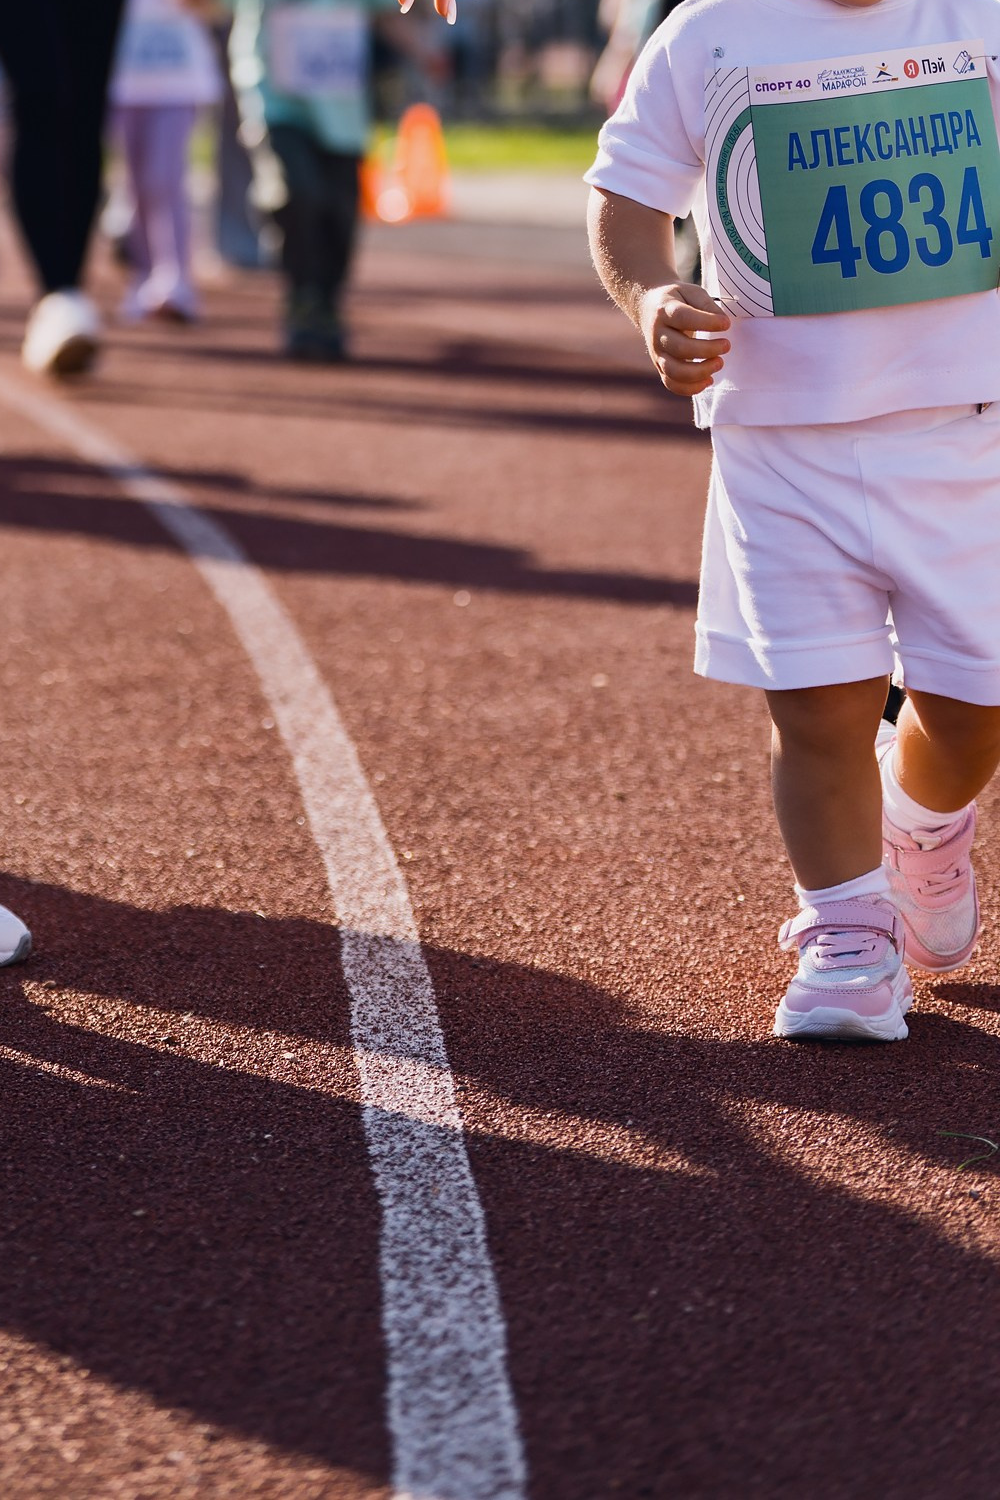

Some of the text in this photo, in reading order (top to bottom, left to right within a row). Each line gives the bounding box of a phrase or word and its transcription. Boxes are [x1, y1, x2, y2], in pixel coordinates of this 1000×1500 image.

[921, 57, 946, 75] Пэй
[755, 81, 793, 92] СПОРТ
[795, 79, 811, 89] 40
[822, 77, 867, 91] МАРАФОН
[788, 109, 982, 171] АЛЕКСАНДРА
[811, 166, 993, 279] 4834
[727, 226, 742, 248] 2012
